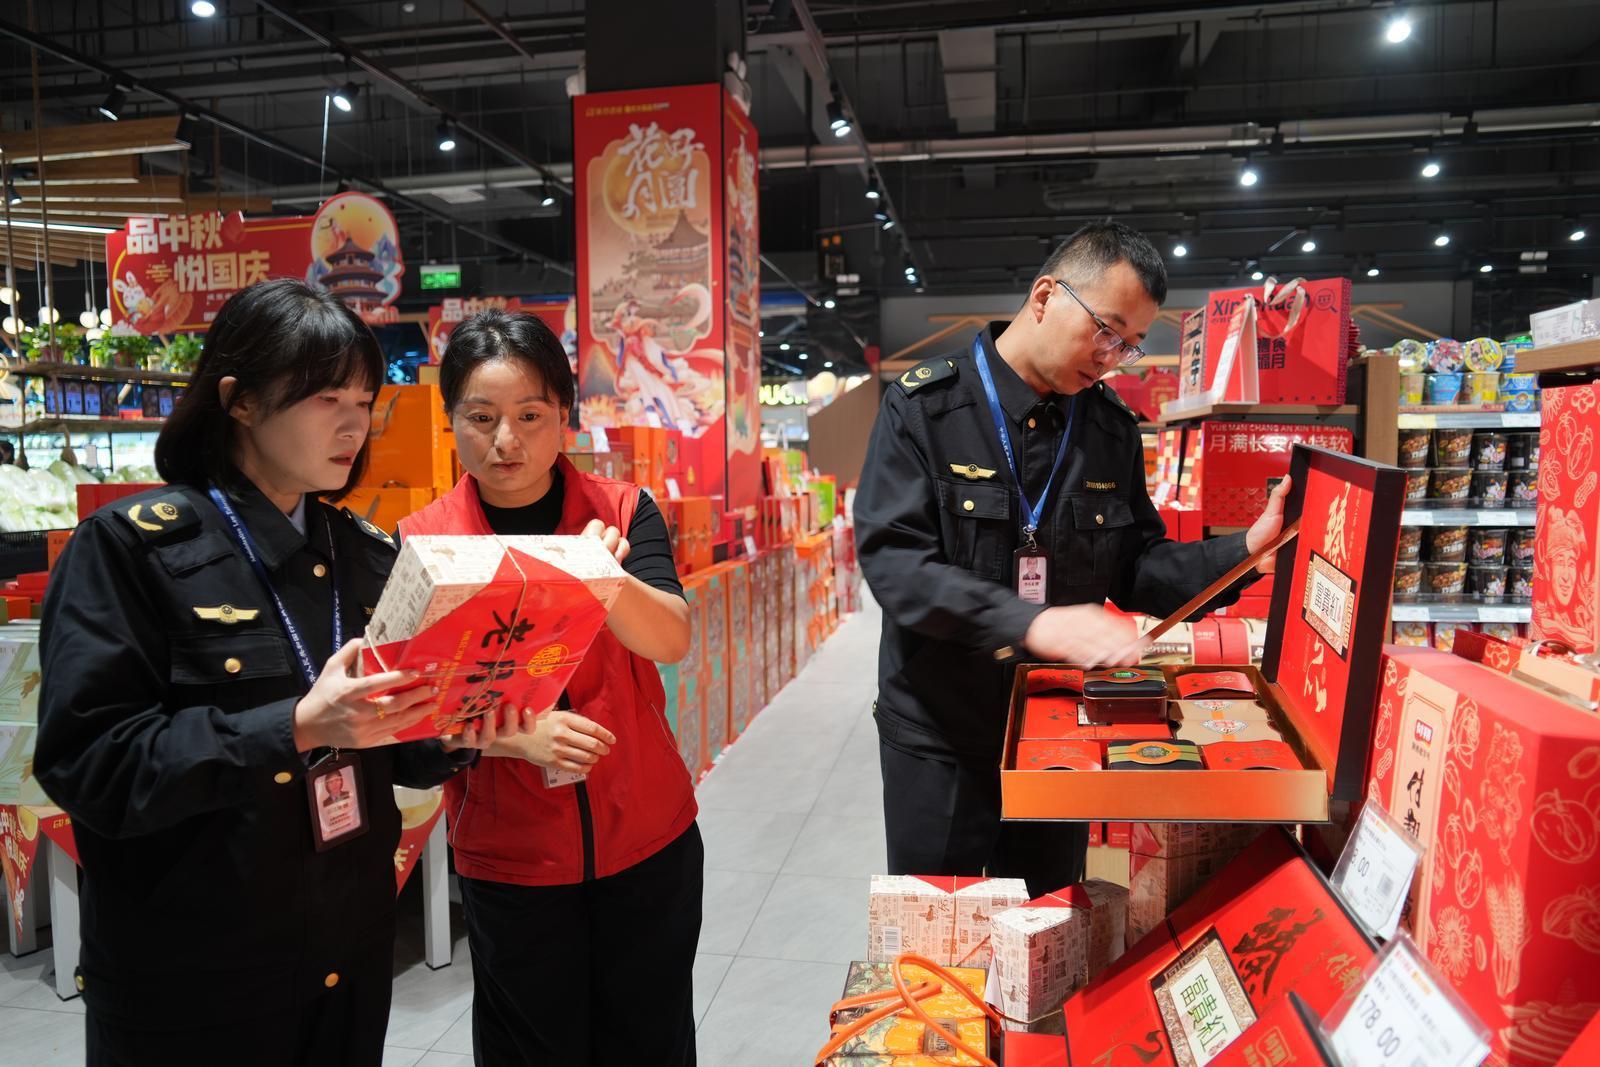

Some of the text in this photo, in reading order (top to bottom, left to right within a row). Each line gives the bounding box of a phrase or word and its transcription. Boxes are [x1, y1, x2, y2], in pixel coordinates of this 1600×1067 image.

[126, 213, 223, 255] 品中秋
[174, 251, 270, 293] 悦国庆
[1228, 424, 1247, 432] MAN
[1250, 424, 1279, 432] CHANG
